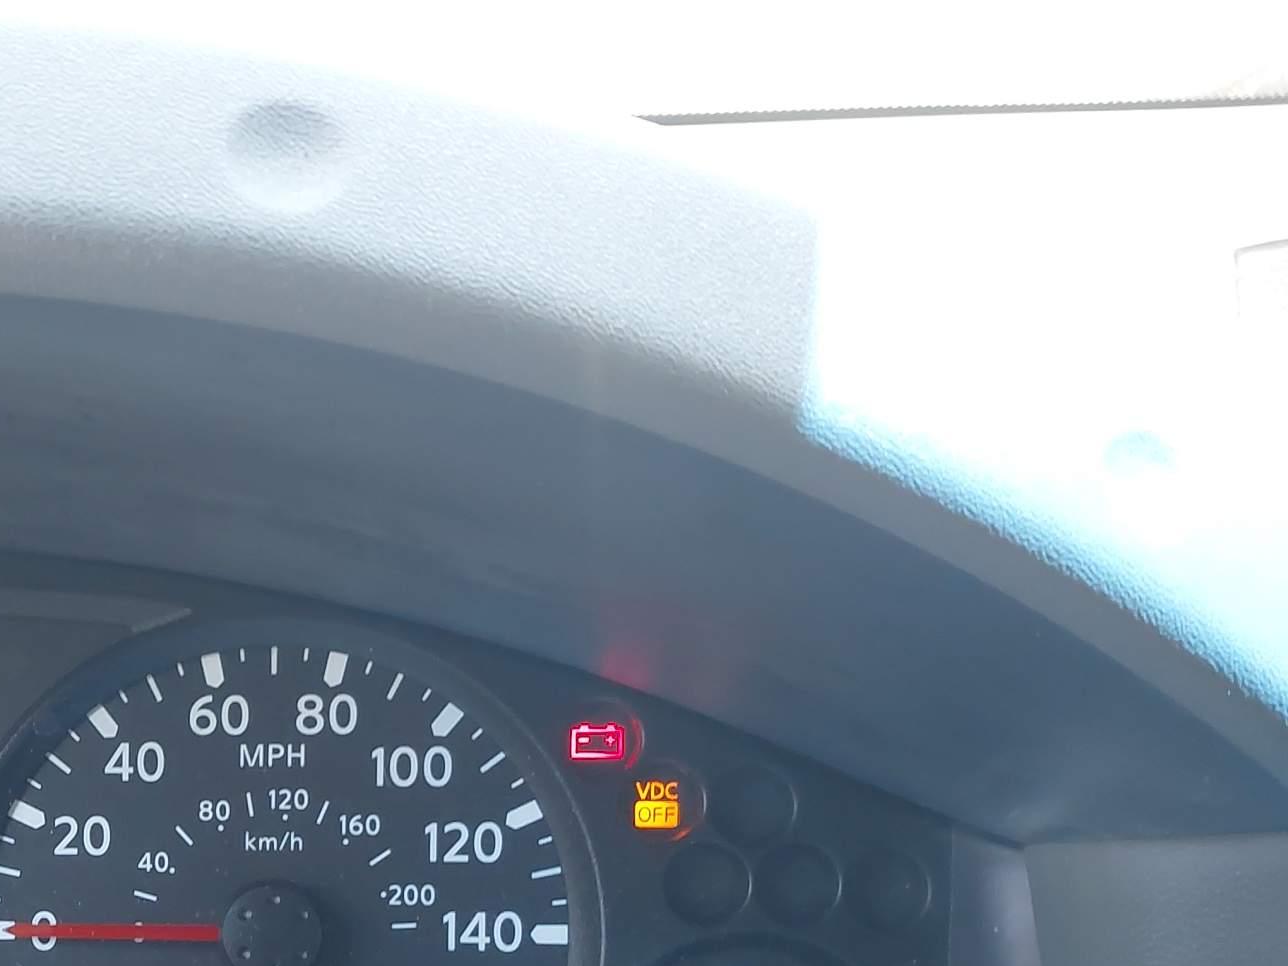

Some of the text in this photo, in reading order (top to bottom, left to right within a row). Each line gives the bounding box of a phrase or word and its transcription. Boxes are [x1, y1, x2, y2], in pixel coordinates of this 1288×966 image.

[189, 694, 250, 736] 60
[295, 693, 358, 736] 80
[104, 741, 165, 782] 40
[238, 743, 307, 768] MPH
[371, 746, 453, 788] 100
[268, 789, 309, 811] 120
[635, 781, 679, 800] VDC
[199, 800, 230, 821] 80
[638, 806, 675, 823] OFF
[53, 816, 111, 857] 20
[340, 815, 381, 836] 160
[244, 829, 303, 852] km/h
[424, 821, 503, 864] 120
[137, 851, 169, 873] 40
[388, 884, 436, 906] 200
[442, 911, 522, 953] 140
